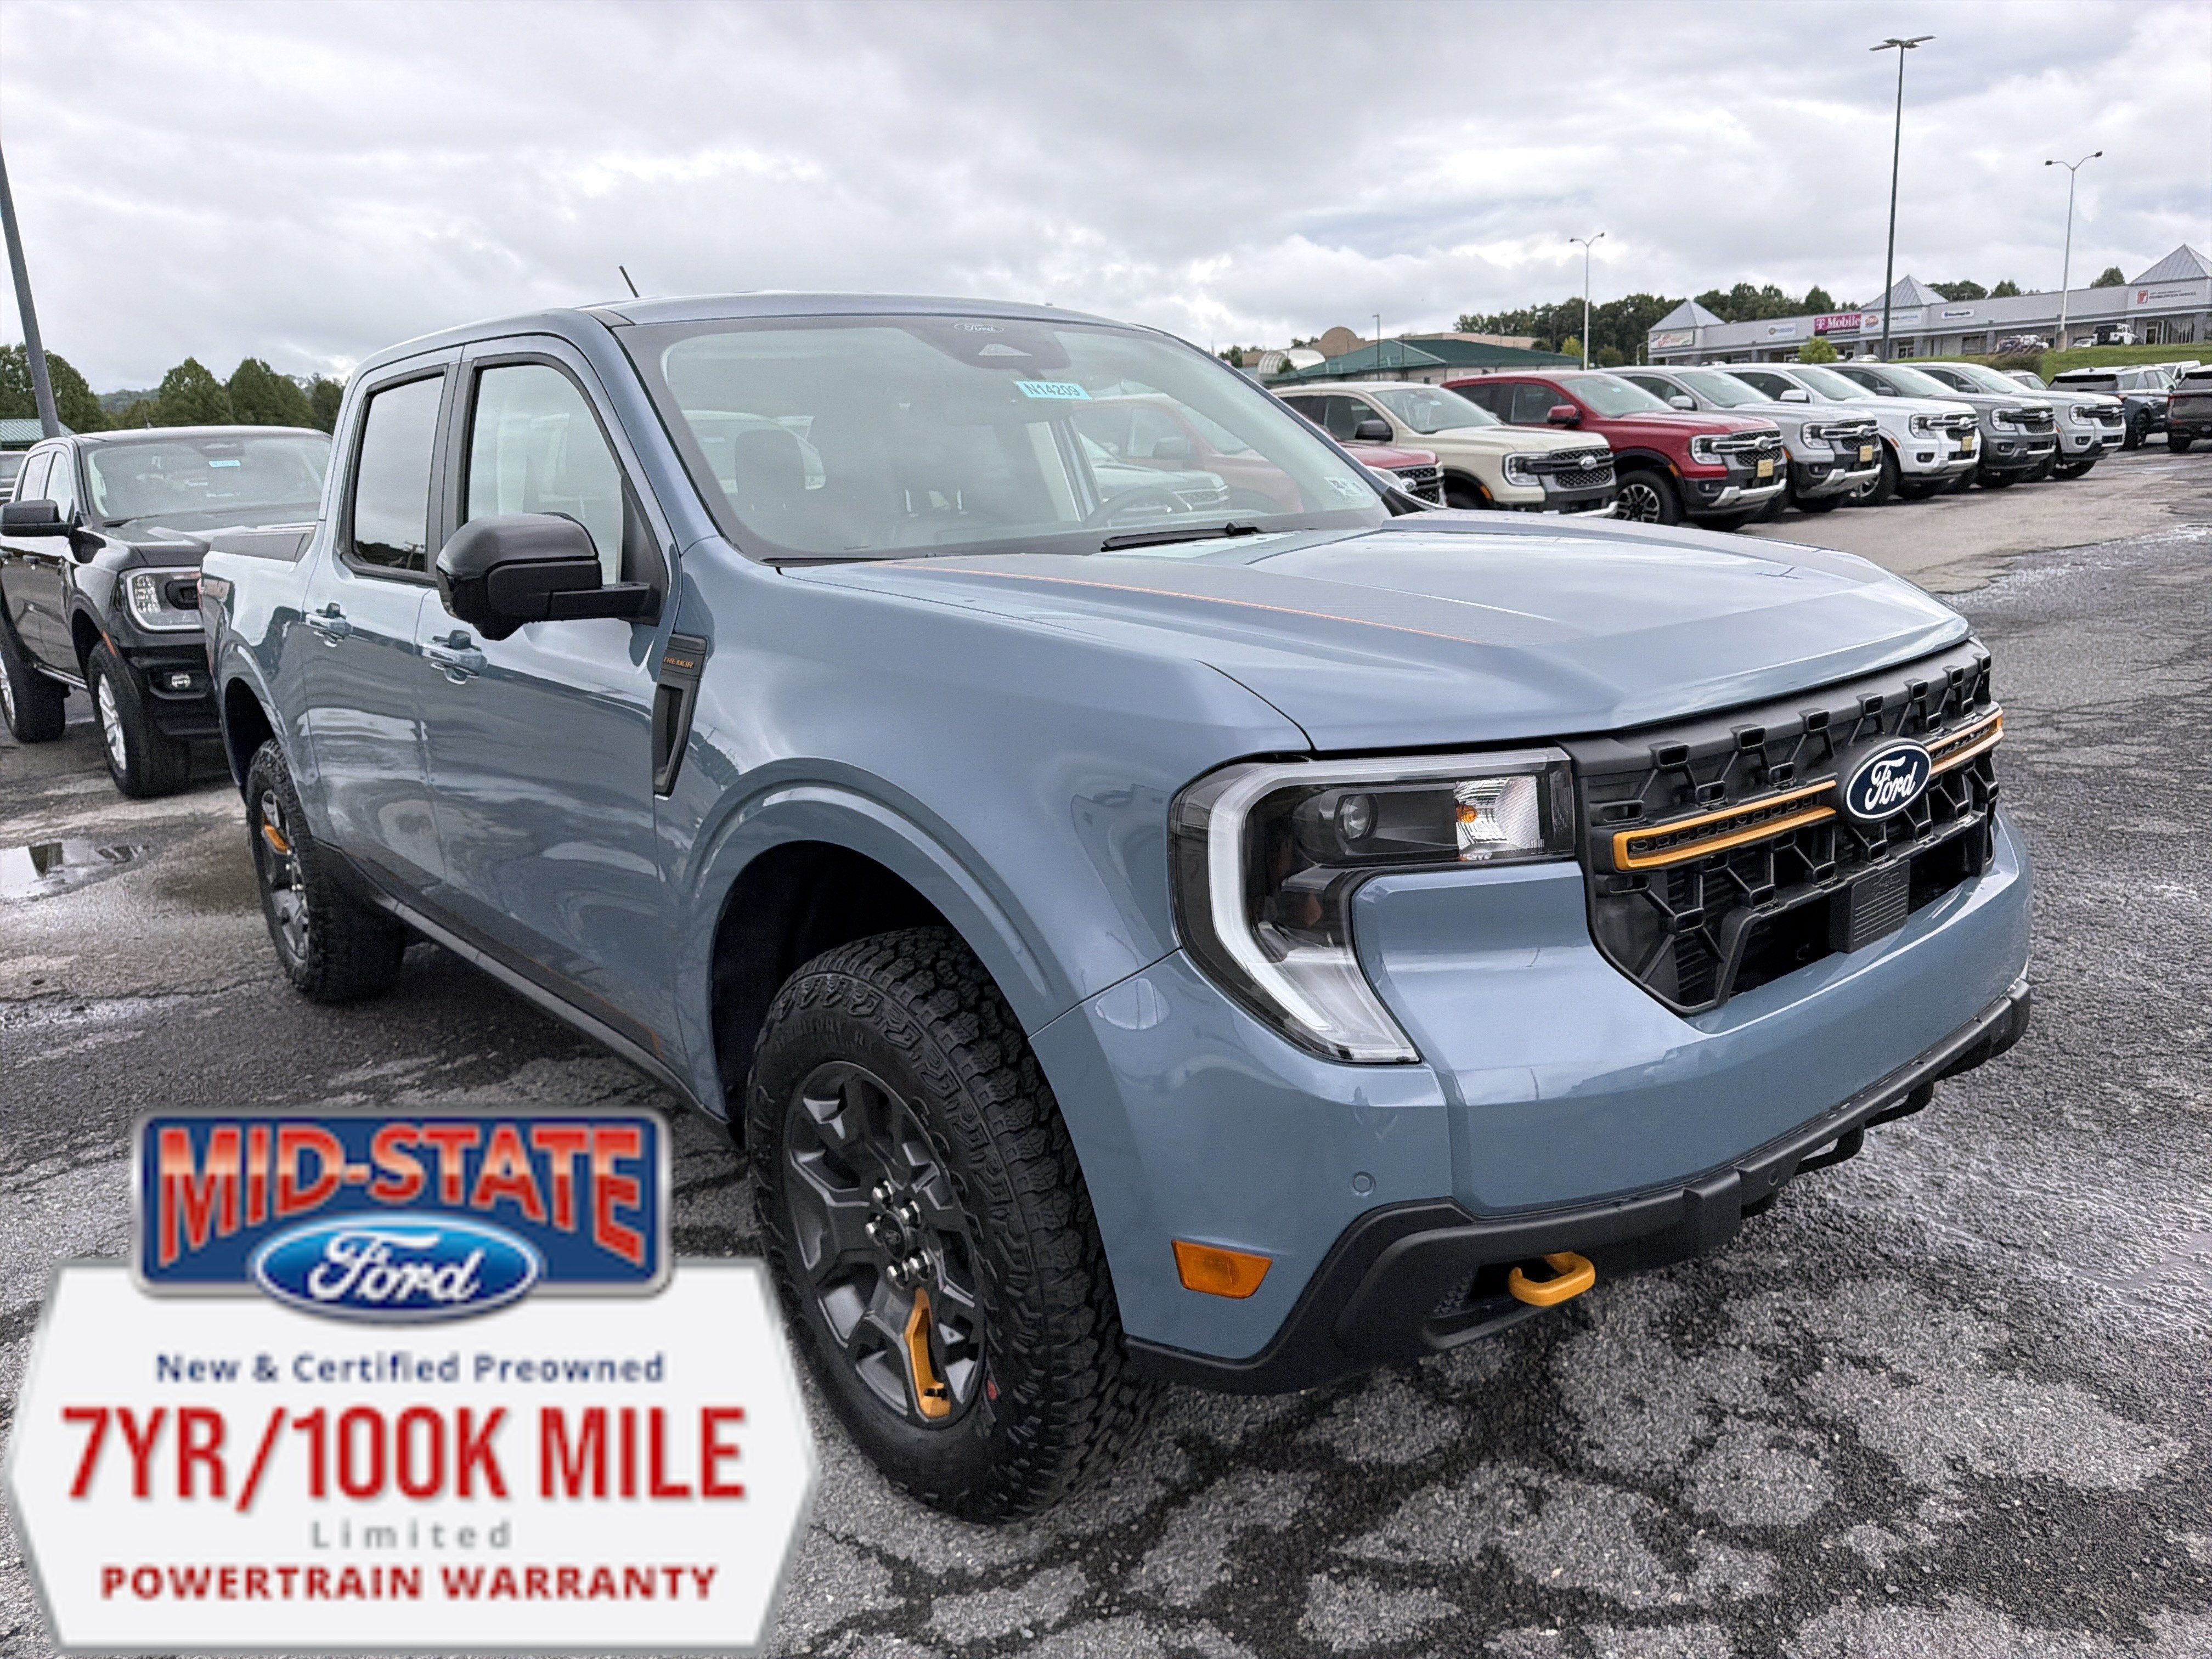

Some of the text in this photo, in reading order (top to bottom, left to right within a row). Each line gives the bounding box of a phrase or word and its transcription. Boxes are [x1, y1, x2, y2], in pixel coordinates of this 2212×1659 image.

[1827, 315, 1861, 329] Mobile
[1023, 383, 1080, 397] N14209
[664, 656, 694, 668] TREMOR
[1865, 755, 1918, 810] Ford
